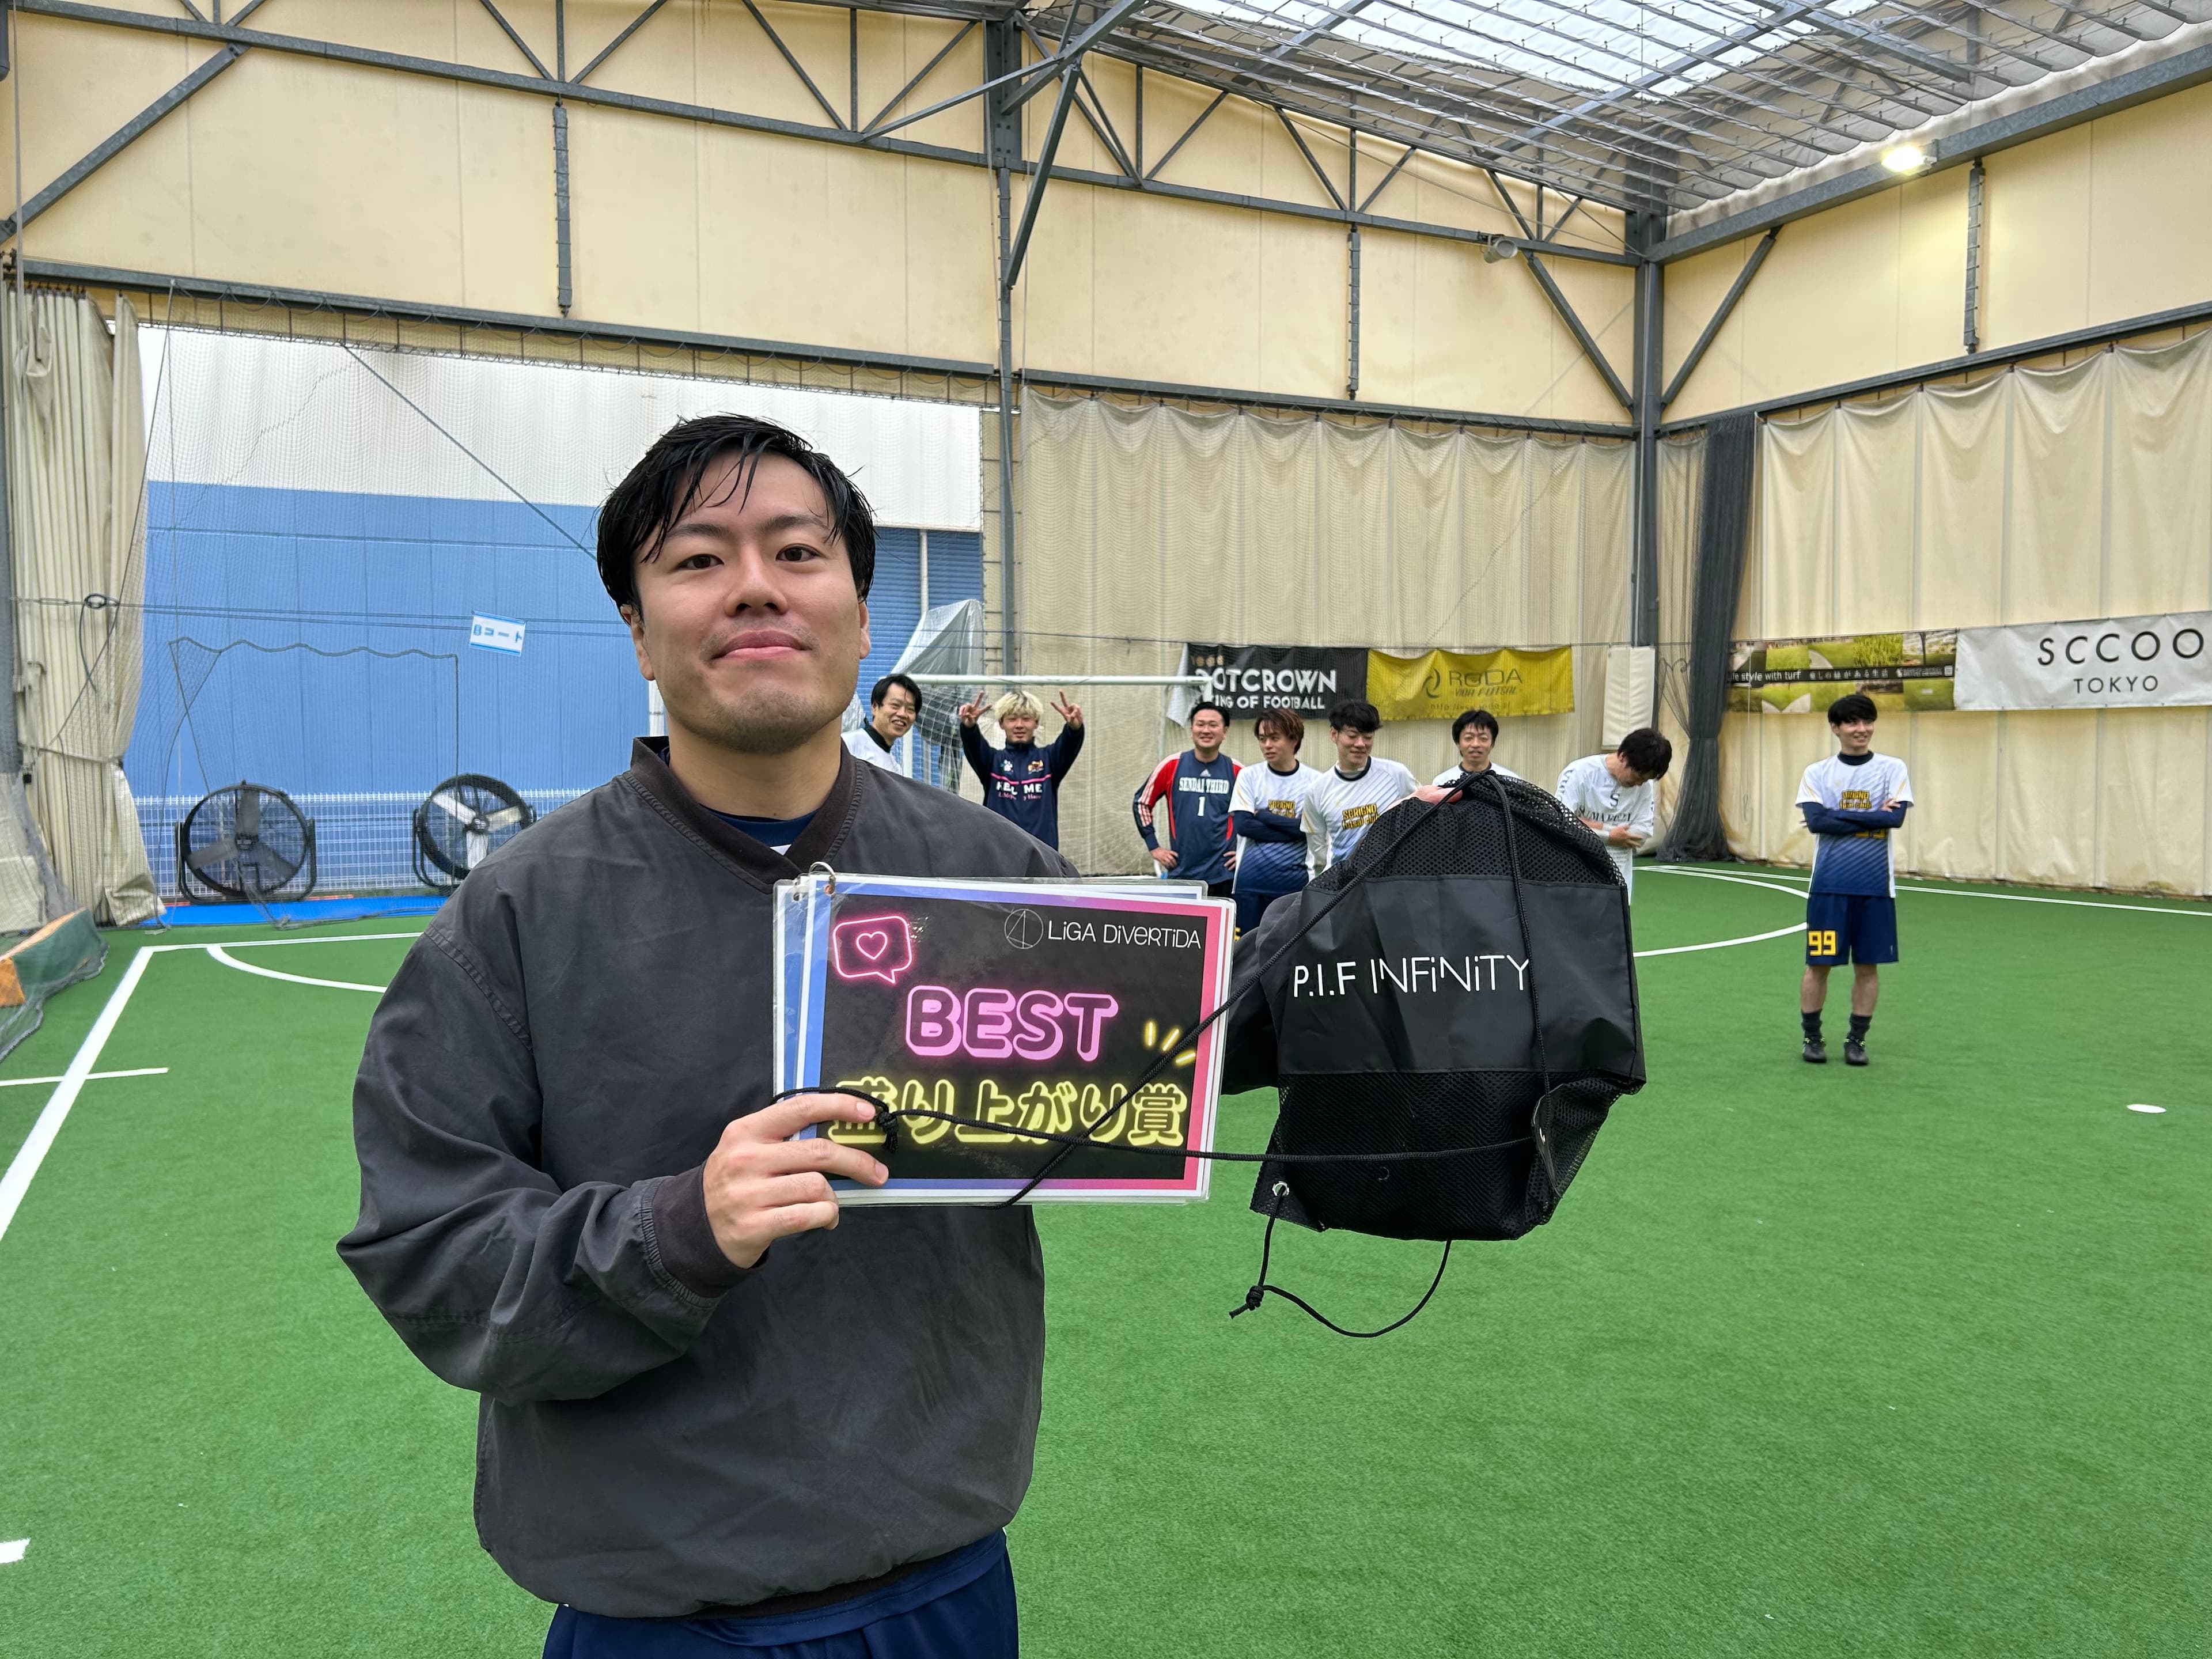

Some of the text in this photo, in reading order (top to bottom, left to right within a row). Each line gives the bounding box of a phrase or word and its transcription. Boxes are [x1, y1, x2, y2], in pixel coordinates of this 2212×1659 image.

[2037, 628, 2205, 666] SCCOO
[1741, 671, 1763, 683] style
[1764, 671, 1782, 681] with
[1785, 669, 1802, 680] turf
[2073, 675, 2158, 694] TOKYO
[1212, 694, 1325, 710] ING OF FOOTBALL
[1205, 778, 1230, 794] THIRD
[1197, 796, 1206, 817] 1
[1808, 930, 1837, 957] 99
[905, 984, 1119, 1062] BEST
